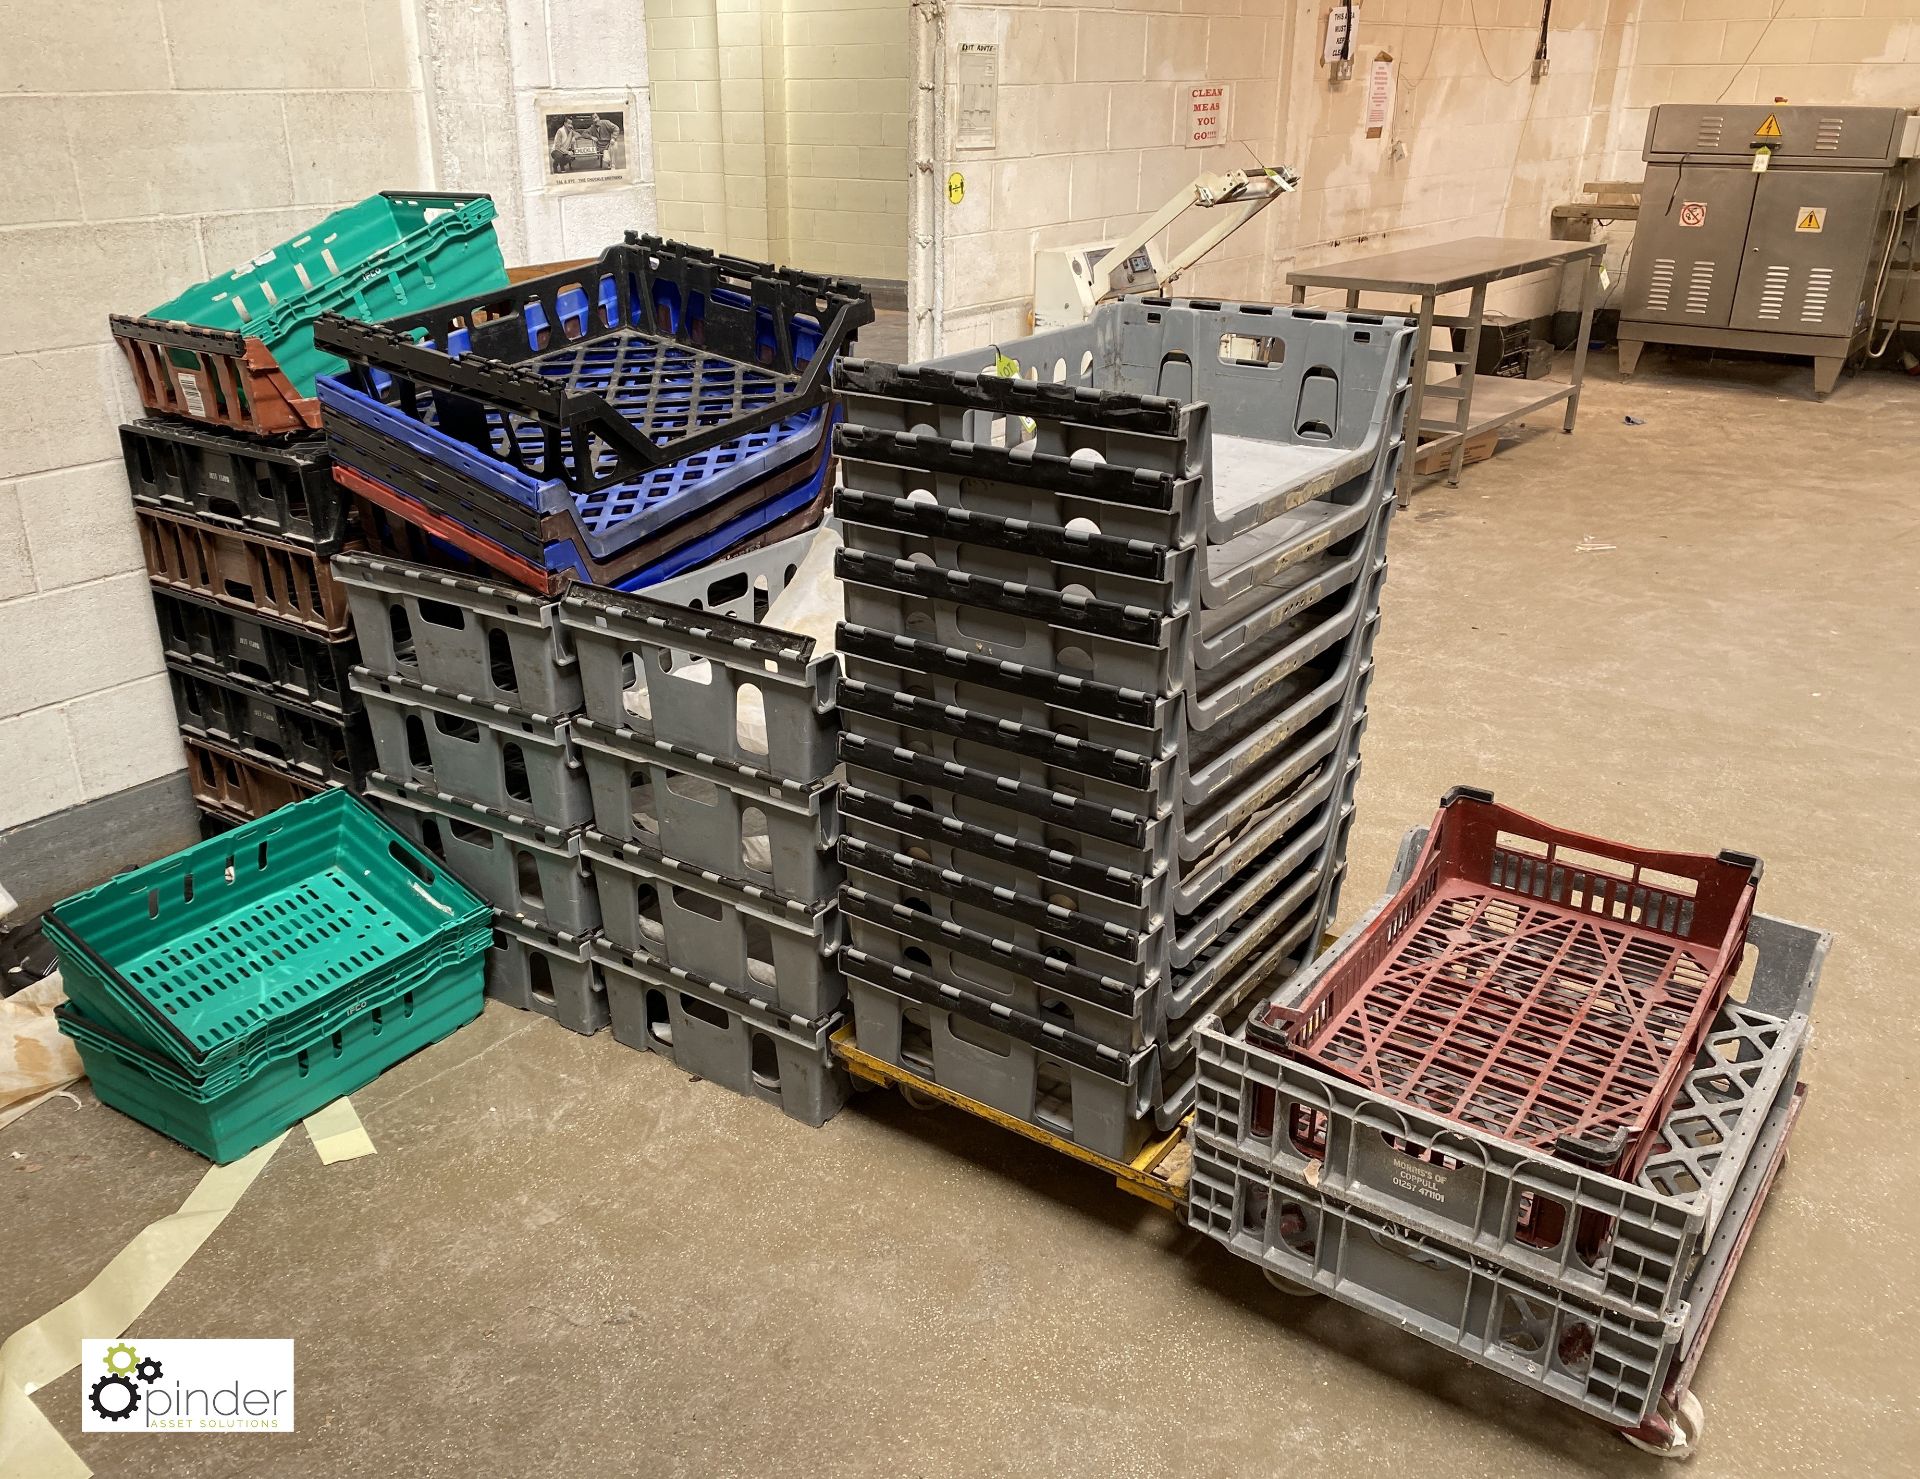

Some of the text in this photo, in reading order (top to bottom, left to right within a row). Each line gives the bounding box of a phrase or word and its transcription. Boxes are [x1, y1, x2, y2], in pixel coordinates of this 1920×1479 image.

[1192, 88, 1223, 98] CLEAN
[1193, 103, 1220, 112] ME AS
[1197, 117, 1216, 126] YOU
[346, 1001, 367, 1016] IFCO
[1393, 1158, 1447, 1184] MORRIS'S OF
[1400, 1170, 1439, 1191] COPPULL
[1392, 1176, 1445, 1203] 01257 471101
